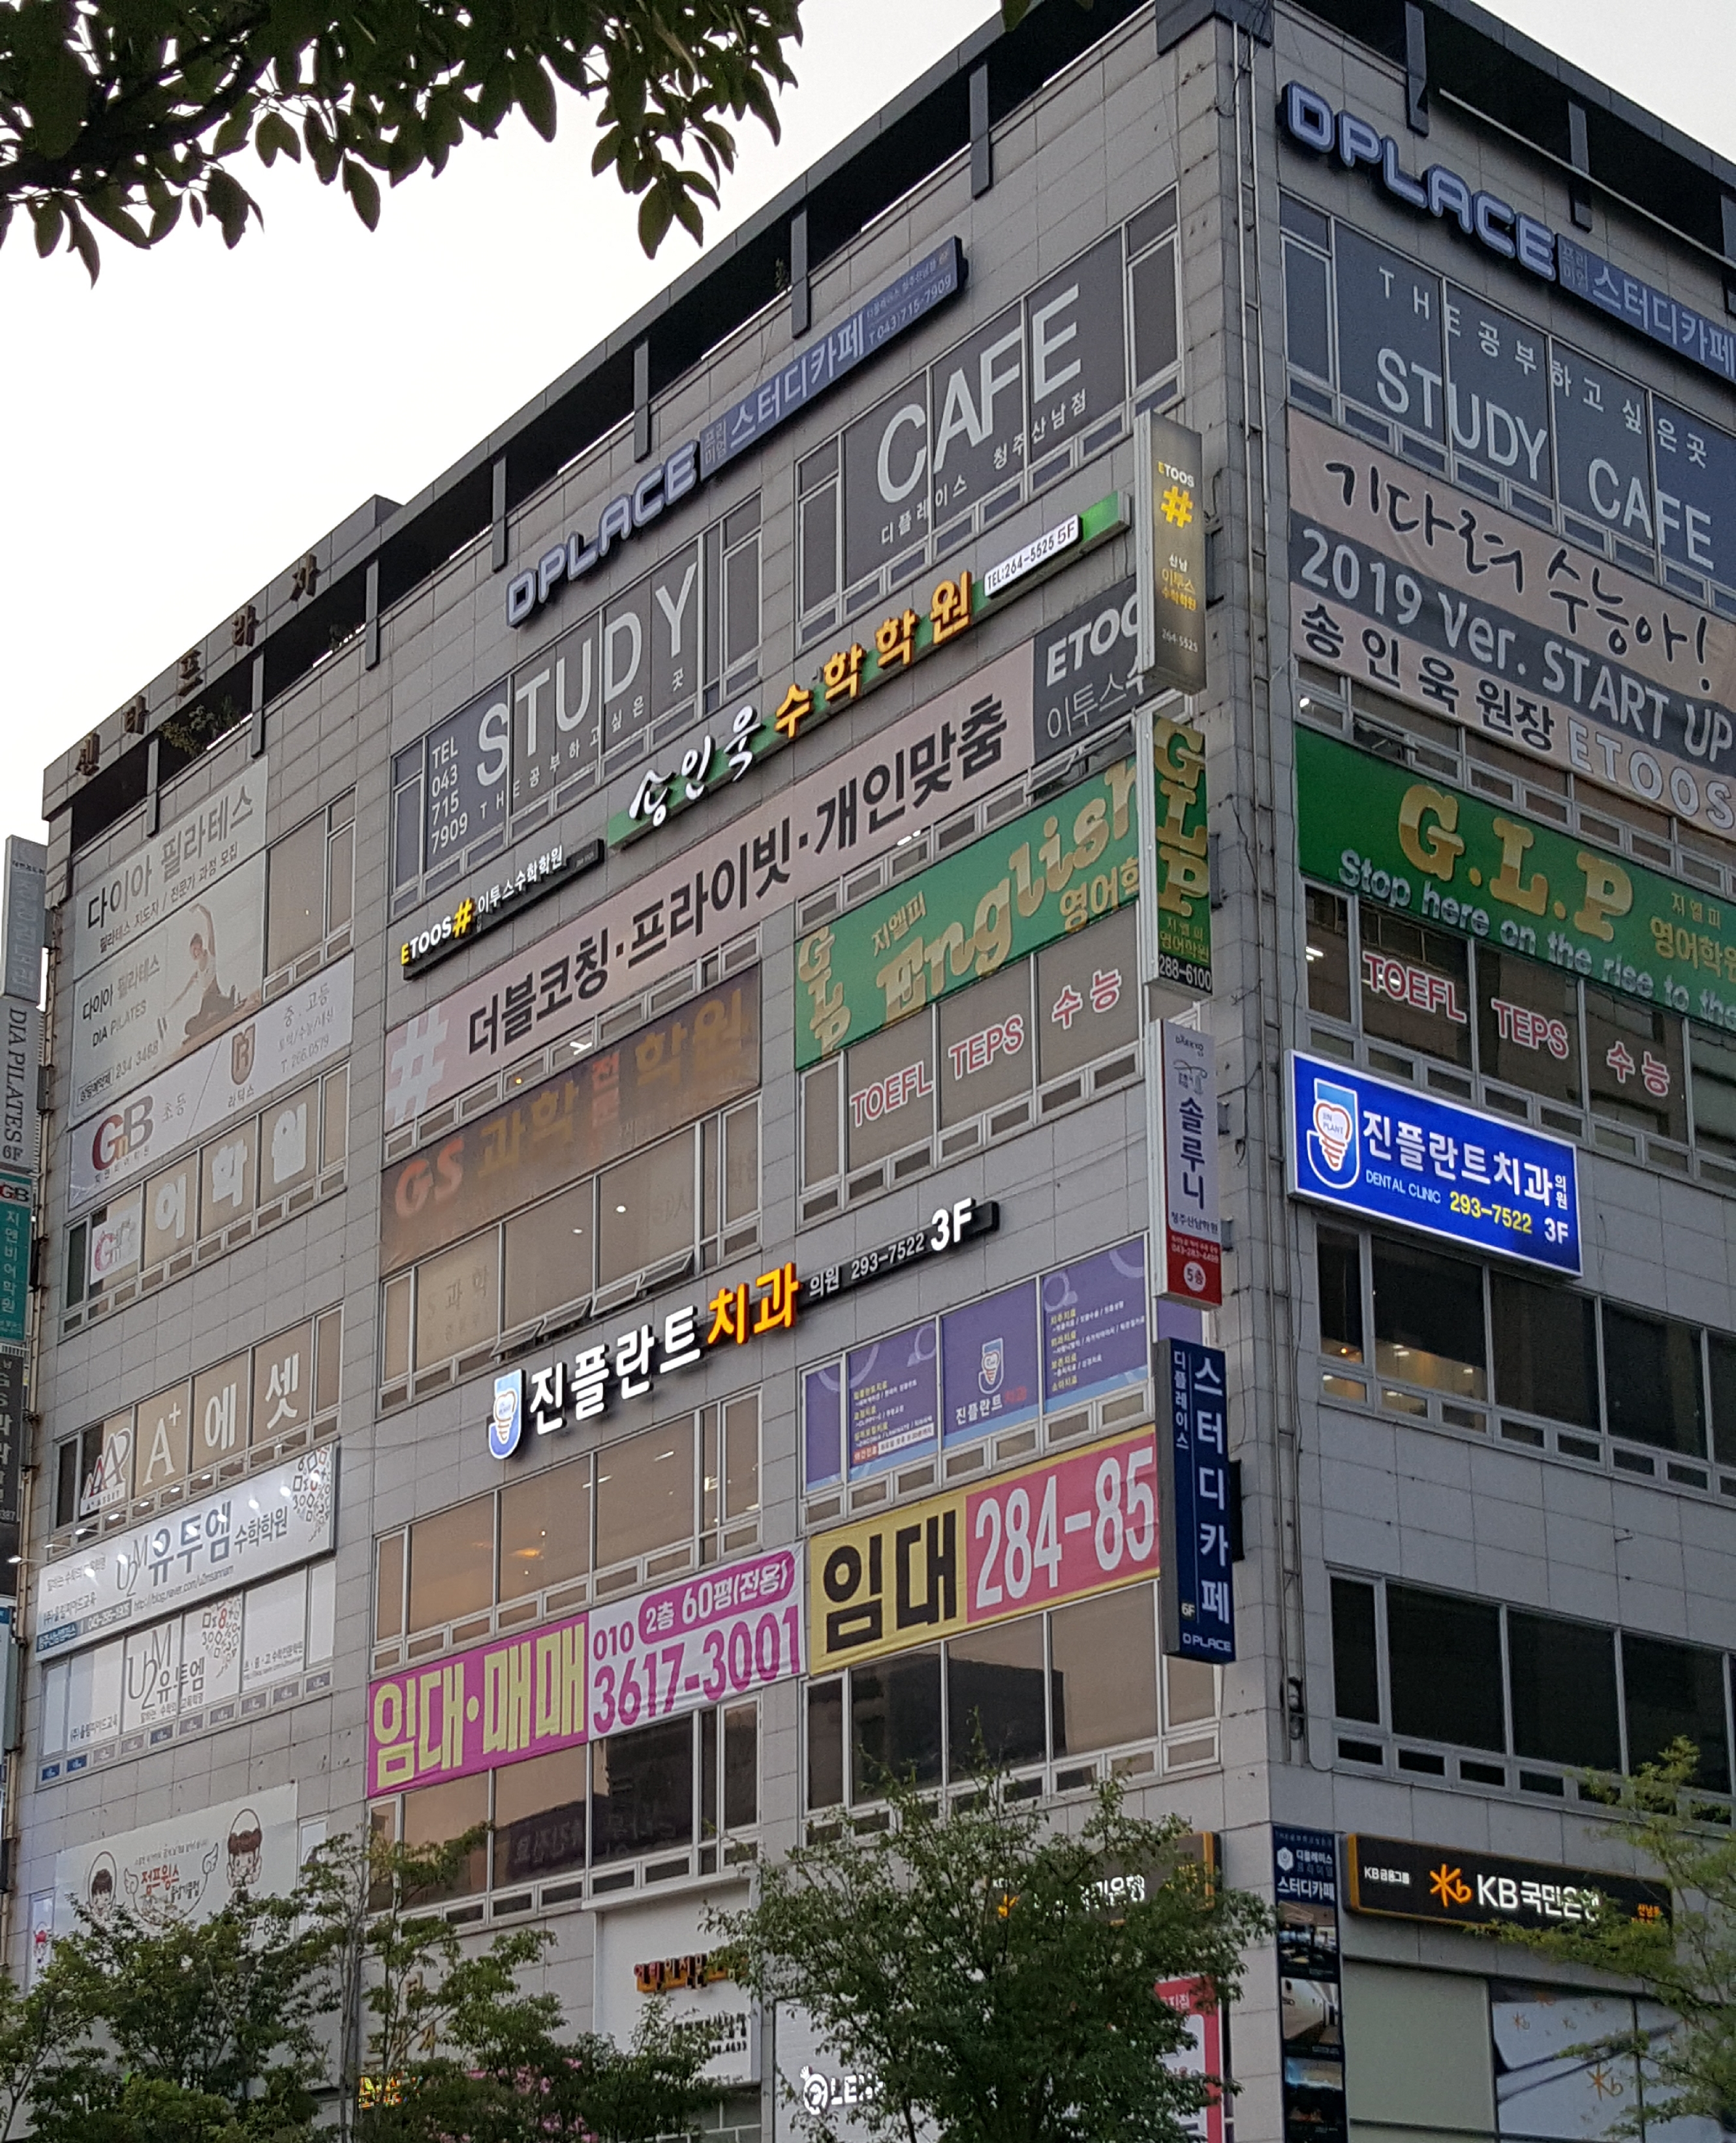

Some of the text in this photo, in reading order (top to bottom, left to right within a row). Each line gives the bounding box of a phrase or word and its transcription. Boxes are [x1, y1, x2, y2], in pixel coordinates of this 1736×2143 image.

[1379, 266, 1461, 337] THE
[1593, 264, 1736, 380] 스터디카페
[730, 312, 865, 448] 스터디카페
[877, 283, 1081, 503] CAFE
[881, 388, 1087, 544] 디플레이스 청주산남점
[1158, 461, 1195, 488] ETOOS
[1376, 347, 1714, 570] STUDY CAFE
[987, 519, 1078, 589] TEL:264-5525 5F
[774, 570, 972, 739] 수학학원
[1046, 592, 1138, 686] ETOO
[1300, 529, 1733, 762] 2019 Ver. START UP
[1547, 547, 1711, 692] 수능아!
[477, 563, 698, 787] STUDY
[1301, 602, 1736, 829] 송인욱 원장 ETOOS
[431, 766, 458, 797] 043
[432, 736, 458, 769] TEL
[480, 779, 521, 820] THE
[87, 785, 253, 929] 다이아 필라테스
[431, 791, 459, 826] 715
[431, 812, 468, 854] 7909
[401, 844, 563, 965] ETOOS 이투스수학학원
[872, 891, 927, 956] 지엘피
[1339, 849, 1411, 908] Stop
[1422, 880, 1489, 938] here
[1500, 918, 1536, 954] on
[1547, 931, 1593, 975] the
[1602, 953, 1654, 999] rise
[1664, 975, 1690, 1013] to
[83, 984, 113, 1021] 다이아
[1159, 953, 1211, 991] 288-6100
[9, 1005, 27, 1043] DIA
[93, 1029, 108, 1047] DIA
[851, 968, 1121, 1127] TOEFL TEPS 수능
[1363, 951, 1670, 1097] TOEFL TEPS 수능
[5, 1045, 25, 1144] PILATES
[2, 1145, 23, 1163] 6F
[395, 1137, 464, 1218] GS
[478, 1080, 580, 1175] 과학
[1179, 1096, 1205, 1210] 솔루니
[1363, 1109, 1568, 1211] 진플란트치과 의원
[809, 1266, 840, 1299] 의원
[850, 1233, 925, 1281] 293-7522
[930, 1197, 973, 1253] 3F
[1366, 1169, 1569, 1245] DENTAL CLINIC 293-7522 3F
[1186, 1267, 1203, 1286] 5층
[956, 1393, 1002, 1425] 진플란트
[1173, 1350, 1189, 1450] 디플레이스
[1194, 1357, 1230, 1624] 스터디카페
[149, 1500, 233, 1587] 유투엠
[234, 1505, 288, 1554] 수학학원
[822, 1509, 957, 1654] 임대
[593, 1621, 634, 1661] 010
[645, 1602, 674, 1635] 2층
[1181, 1603, 1196, 1618] 6F
[157, 1656, 205, 1704] 유투엠
[593, 1605, 801, 1733] 3617-3001
[1277, 1875, 1335, 1901] 스터디카페
